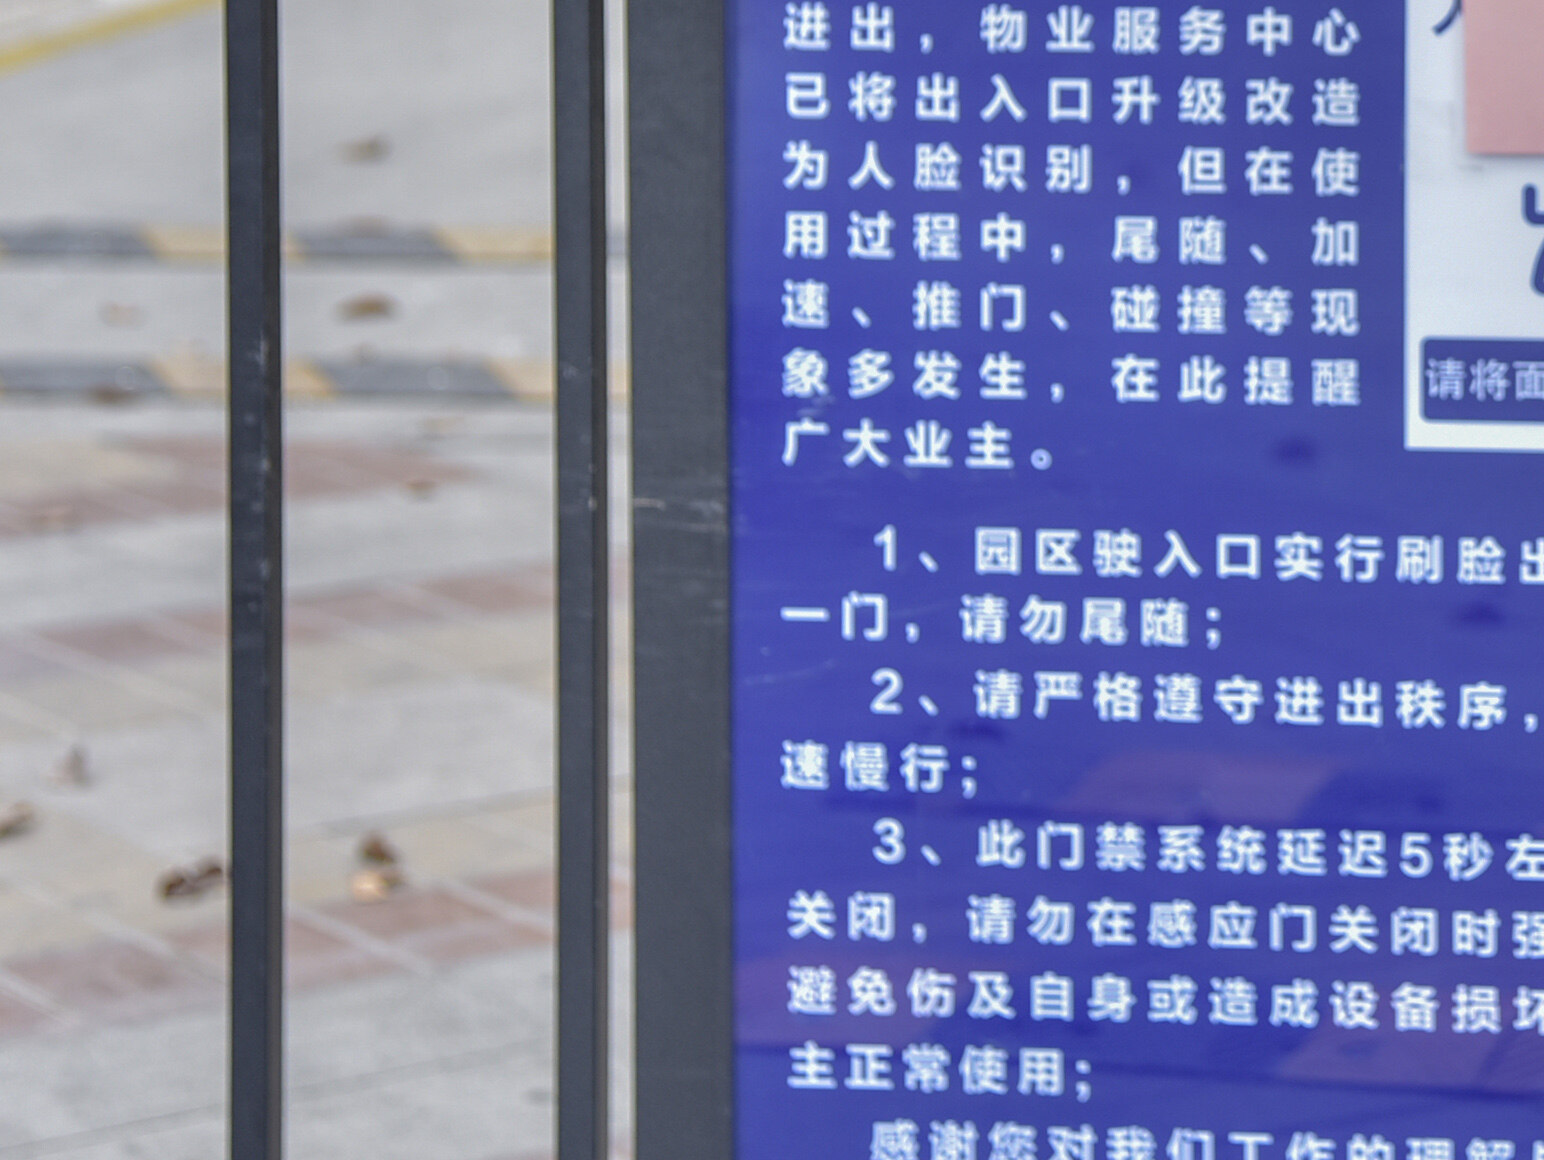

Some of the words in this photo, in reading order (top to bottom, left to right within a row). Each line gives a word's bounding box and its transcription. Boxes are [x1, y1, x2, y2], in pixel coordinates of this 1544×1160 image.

[783, 2, 1359, 55] 进出，物业服务中心
[786, 72, 1358, 125] 已将出入口升级改造
[783, 140, 1358, 195] 为人脸识别，但在使
[784, 211, 1357, 265] 用过程中，尾随、加
[782, 279, 1358, 335] 速、推门、碰撞等现
[783, 348, 1358, 404] 象多发生，在此提醒
[783, 418, 1051, 469] 广大业主。
[781, 592, 1219, 648] 一门，请勿尾随；
[781, 741, 975, 796] 速慢行；
[788, 1041, 1090, 1099] 主正常使用；
